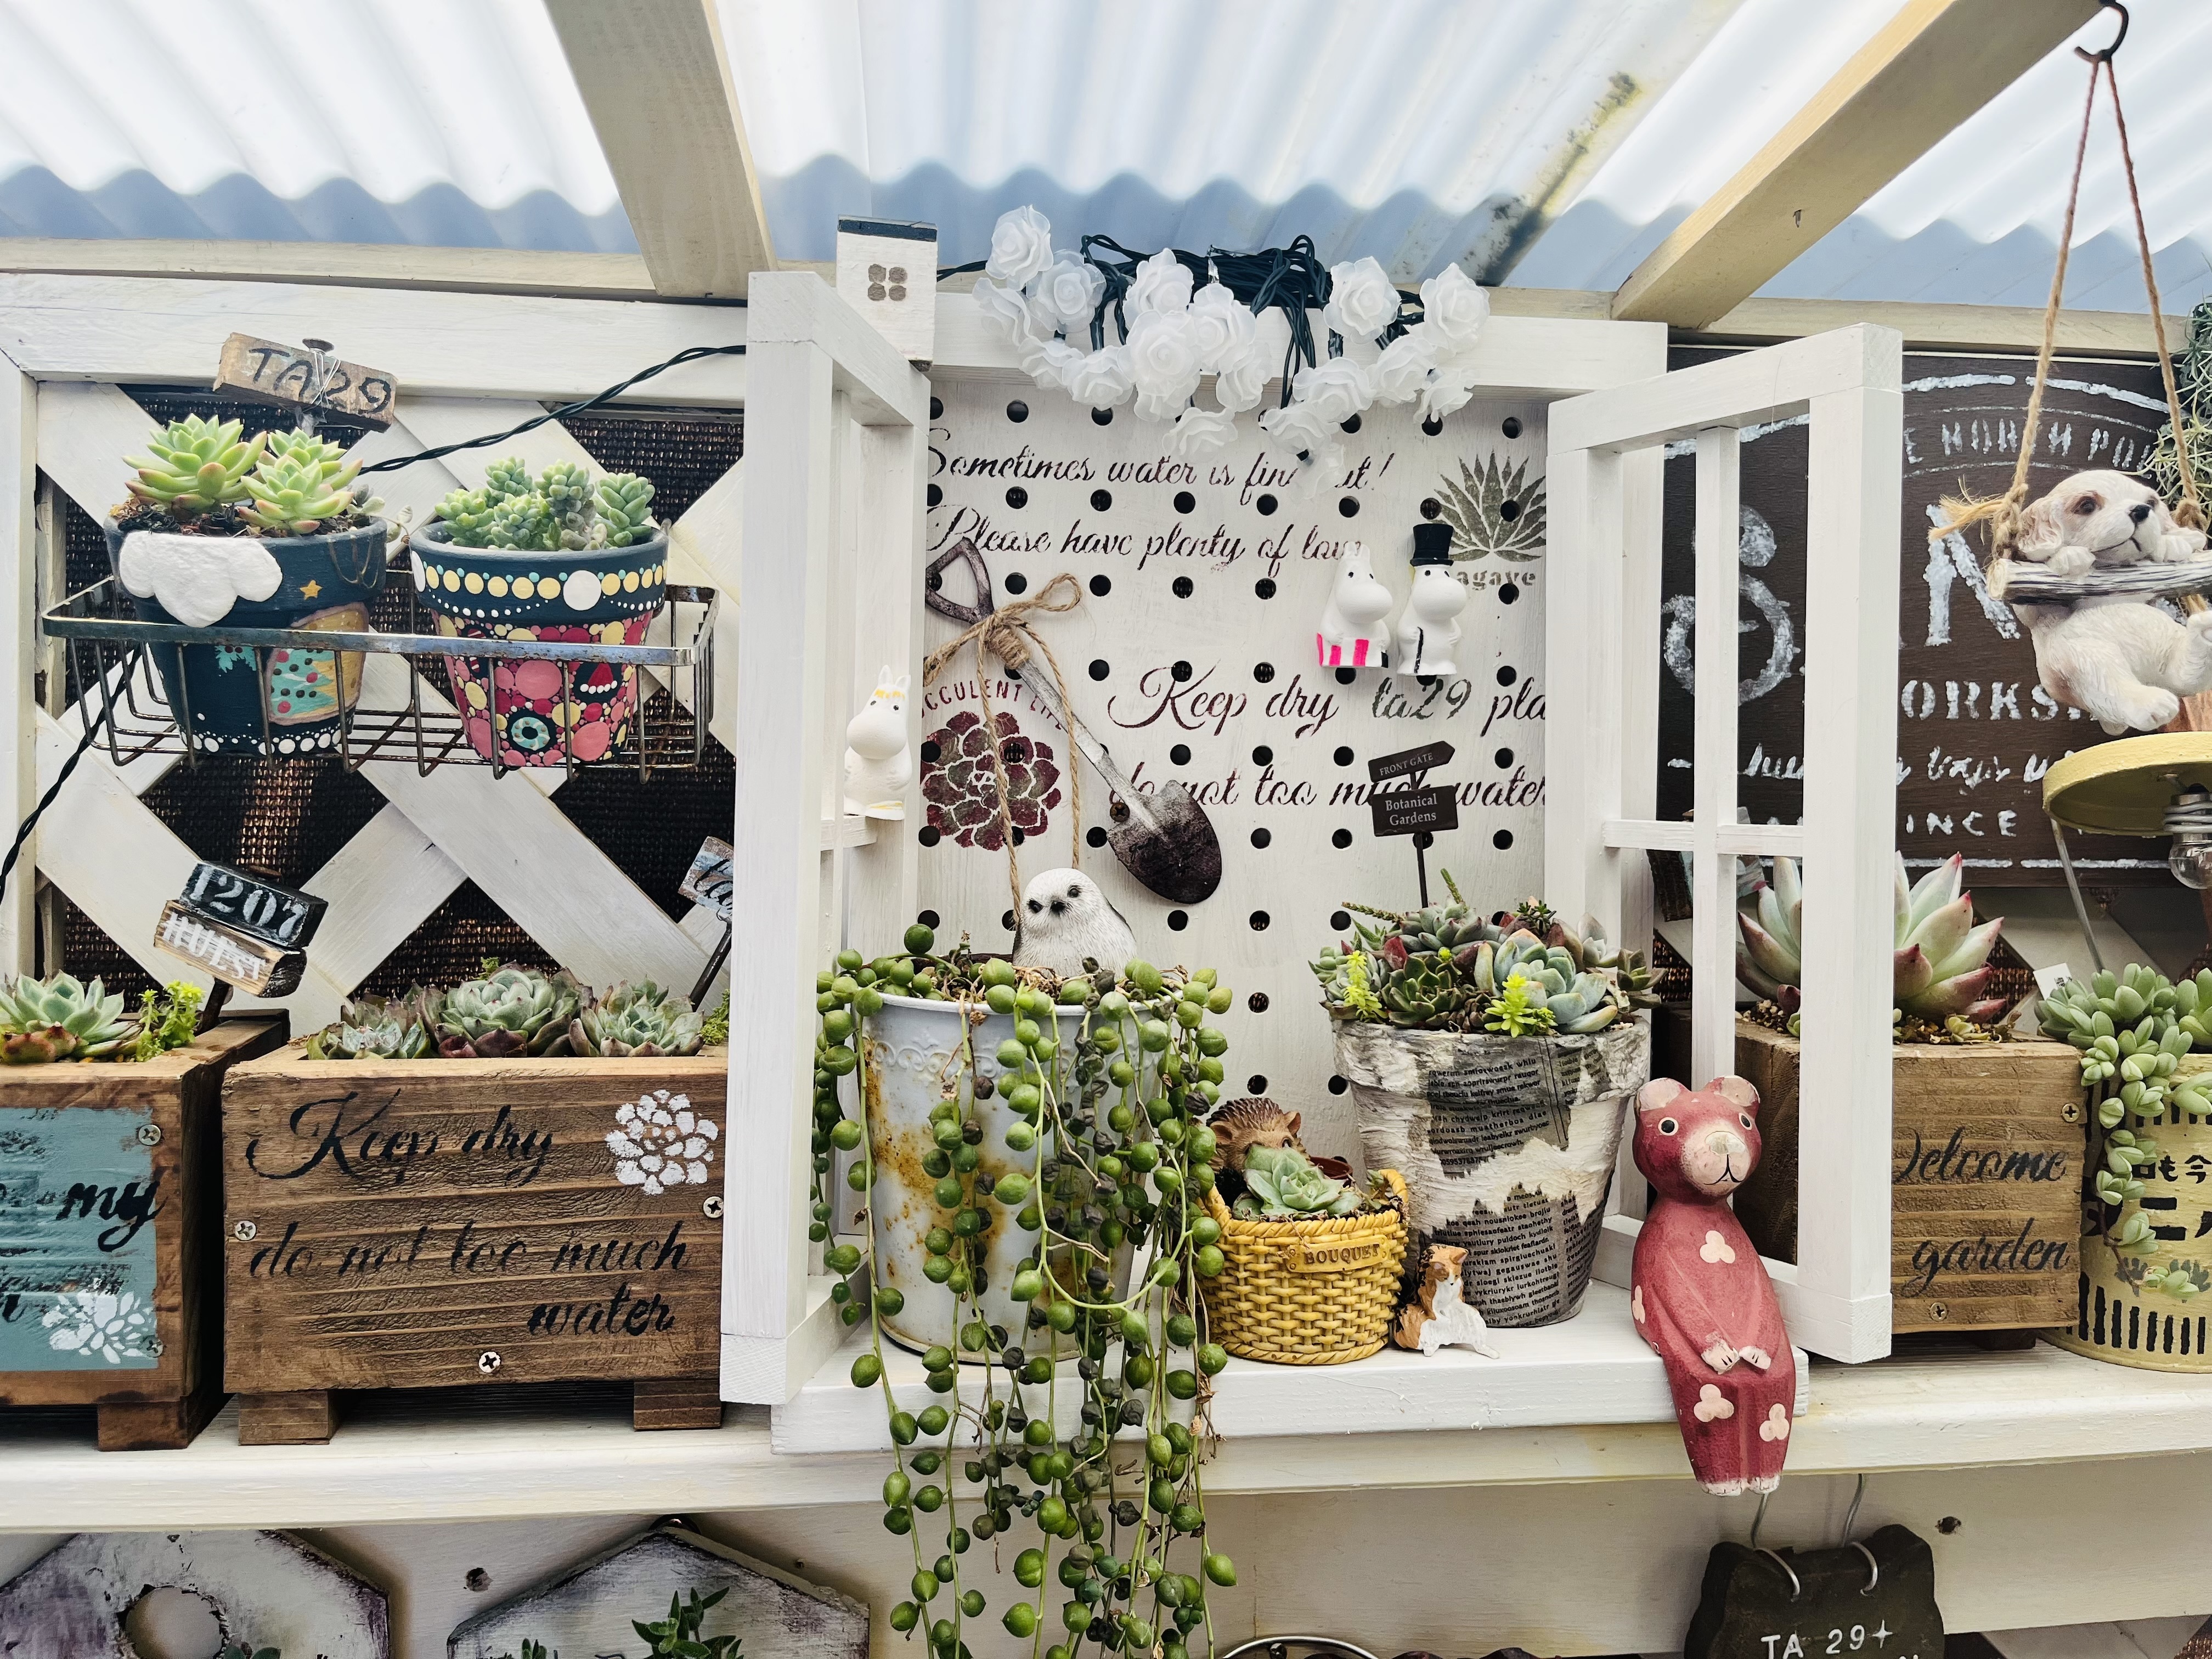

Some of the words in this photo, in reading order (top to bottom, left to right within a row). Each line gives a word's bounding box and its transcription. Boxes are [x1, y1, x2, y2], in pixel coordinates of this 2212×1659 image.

[1108, 455, 1197, 485] water
[1209, 465, 1235, 486] is
[1240, 452, 1299, 505] fin
[1060, 519, 1133, 556] have
[1137, 521, 1245, 571] plenty
[1258, 524, 1294, 578] of
[1302, 525, 1361, 560] lov
[1457, 570, 1536, 590] agave
[1108, 658, 1247, 736] Keep
[1265, 674, 1339, 738] dry
[1255, 764, 1317, 805] too
[1380, 760, 1407, 776] FRONT
[1410, 752, 1434, 766] GATE
[1385, 793, 1437, 811] Botanical
[1390, 812, 1436, 826] Gardens
[1906, 810, 2017, 837] INCE
[189, 864, 308, 939] 1207
[245, 1087, 441, 1184] Keep
[462, 1104, 553, 1187] dry
[1894, 1126, 2067, 1184] elcome
[56, 1181, 168, 1252] my
[250, 1221, 319, 1277] do
[338, 1226, 429, 1276] not
[451, 1220, 527, 1272] too
[551, 1220, 689, 1273] much
[1304, 1244, 1380, 1264] BOUQUET
[1902, 1218, 2069, 1297] garden
[526, 1282, 676, 1336] water
[1760, 1633, 1803, 1659] TA
[1825, 1624, 1865, 1655] 29
